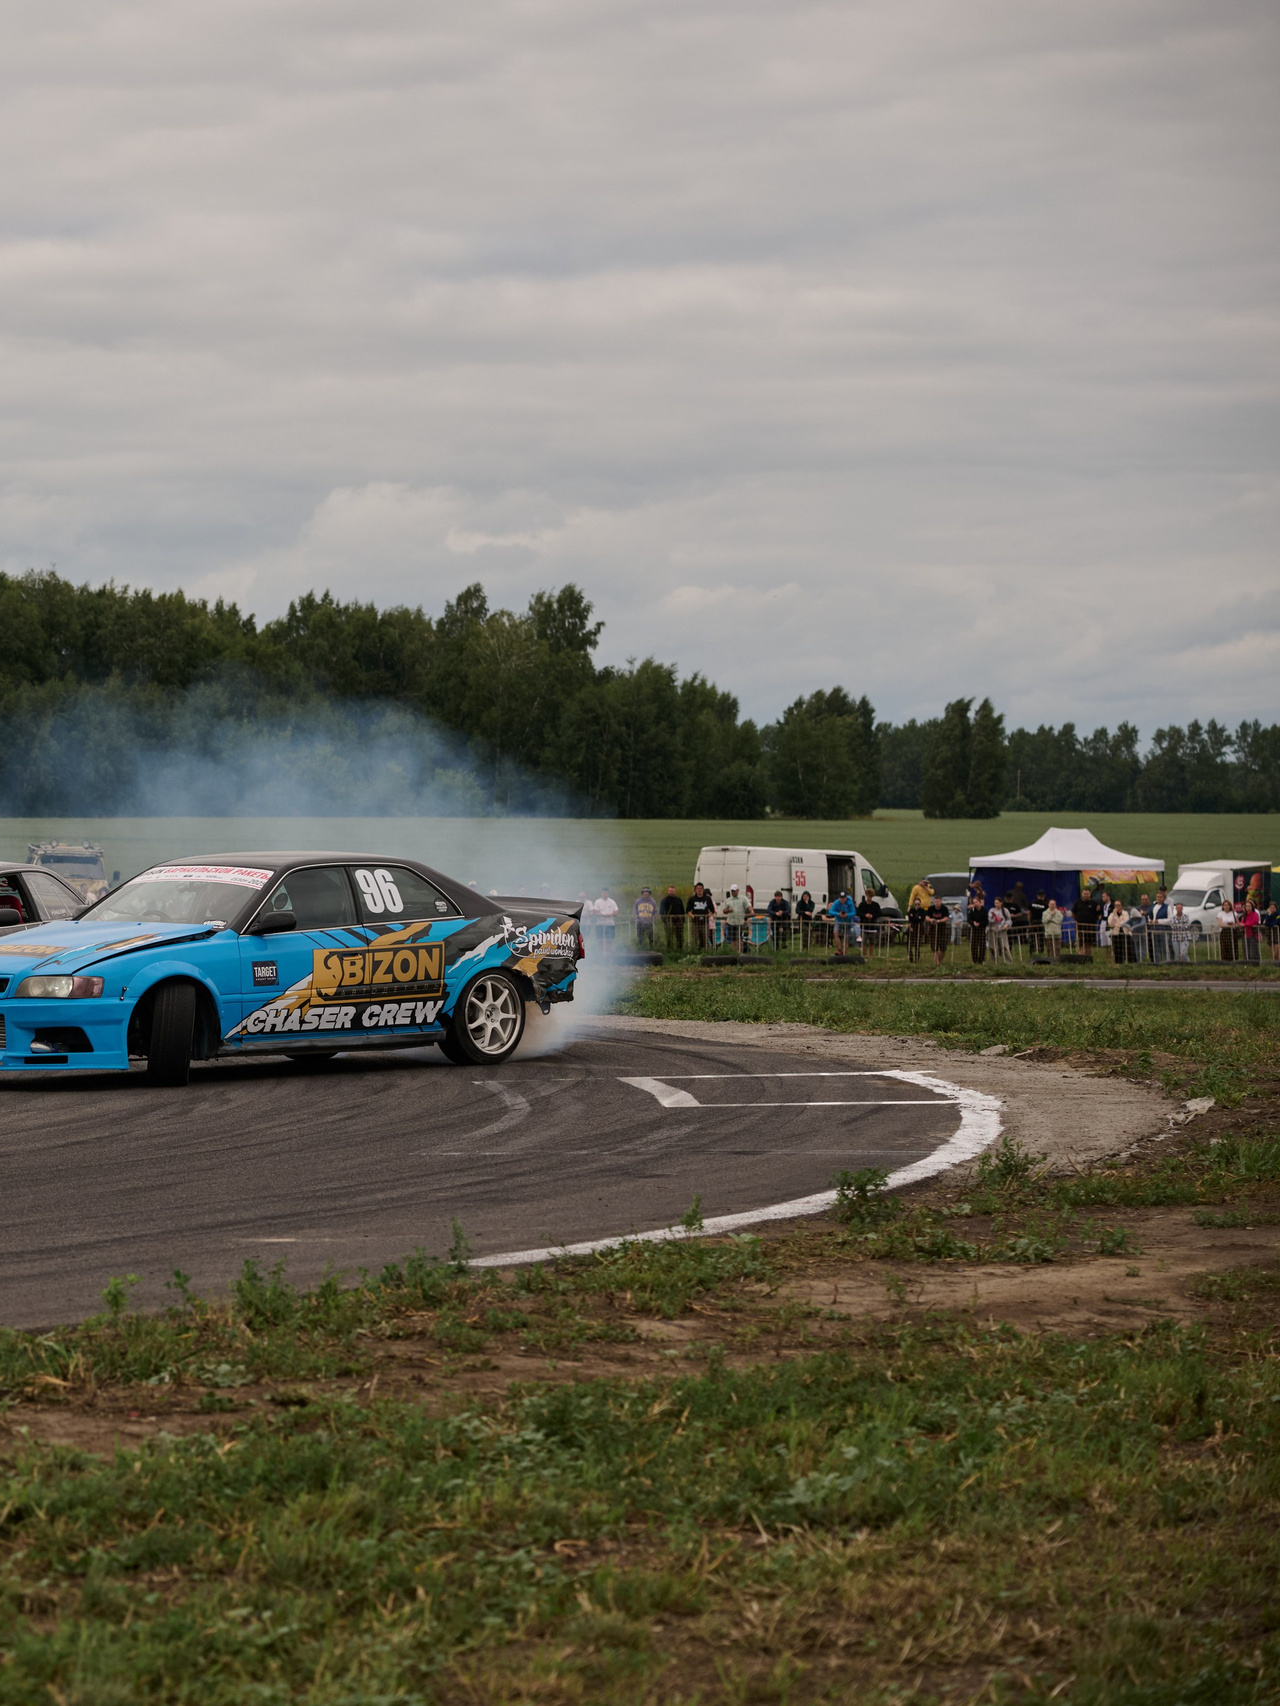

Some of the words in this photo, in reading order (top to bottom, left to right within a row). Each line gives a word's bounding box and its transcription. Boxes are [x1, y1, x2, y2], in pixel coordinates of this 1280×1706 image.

[355, 869, 404, 913] 96
[515, 926, 575, 952] Spiridon
[254, 966, 276, 978] TARGET
[341, 948, 440, 986] BIZON
[340, 984, 439, 996] АВТОДЕТАЛЬ
[246, 1005, 357, 1034] CHASER
[362, 1000, 444, 1027] CREW
